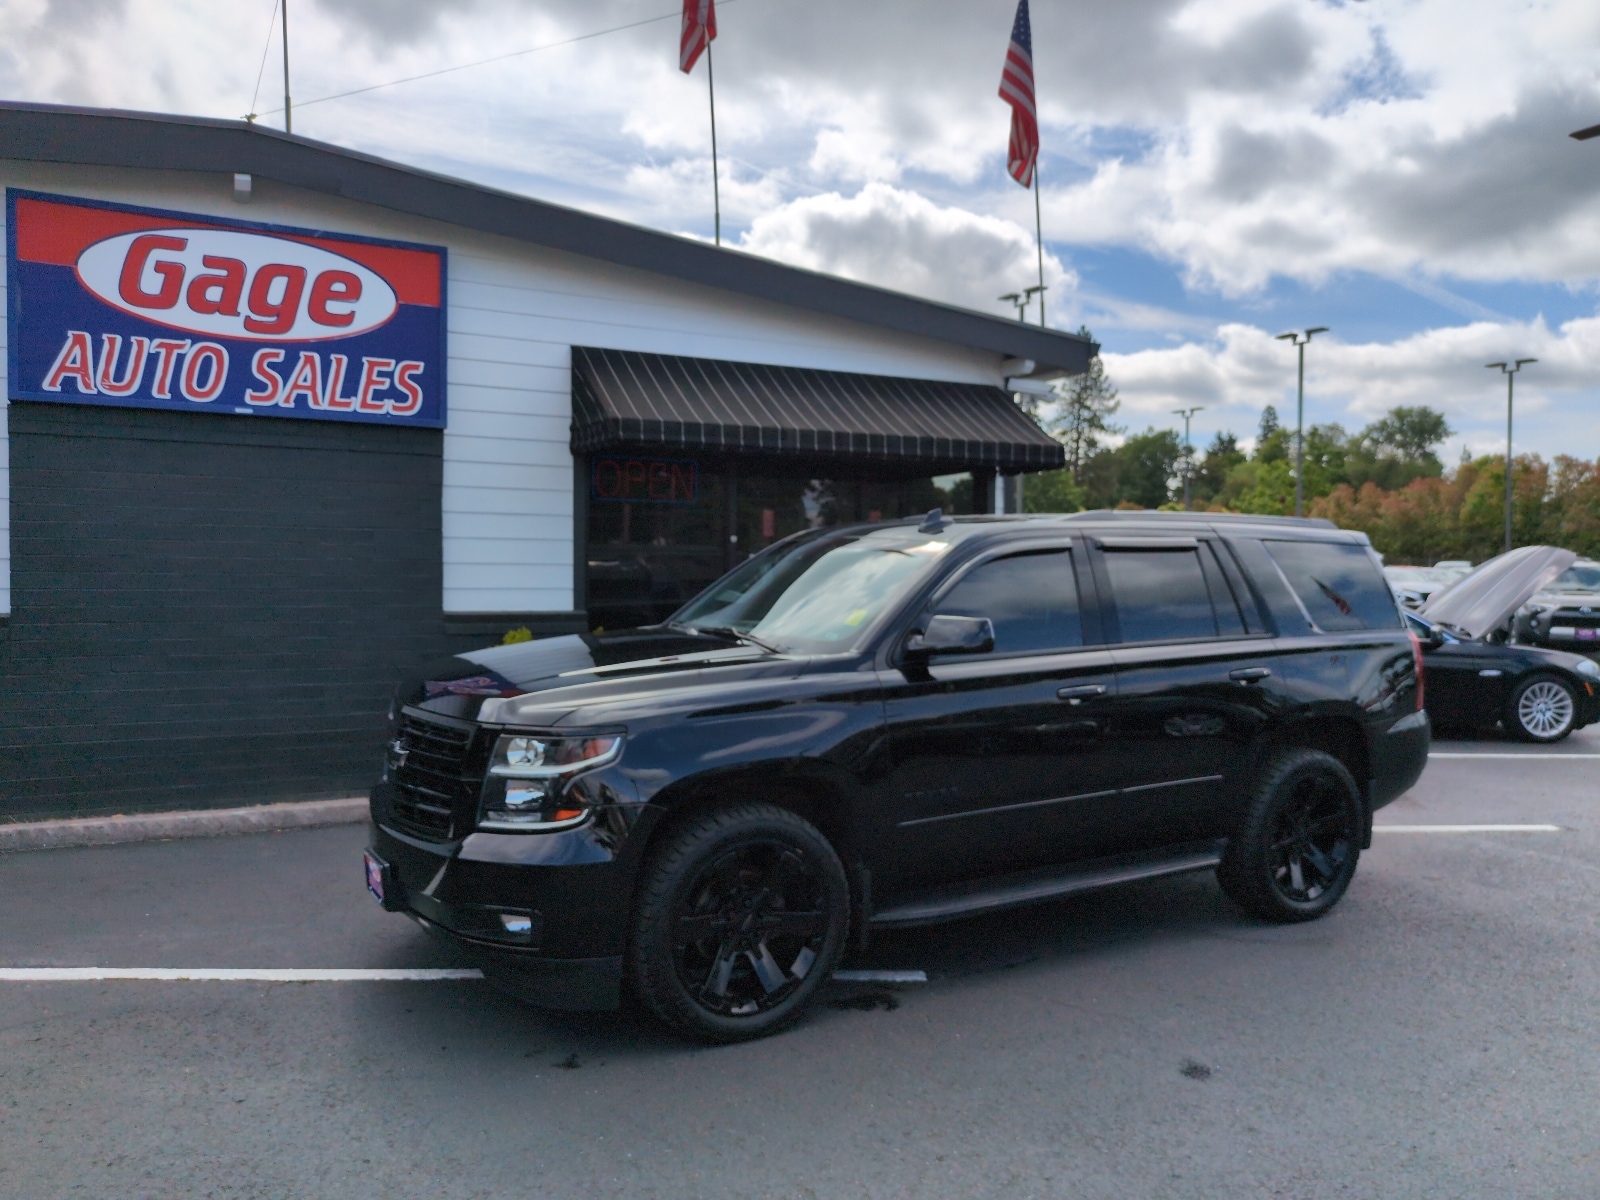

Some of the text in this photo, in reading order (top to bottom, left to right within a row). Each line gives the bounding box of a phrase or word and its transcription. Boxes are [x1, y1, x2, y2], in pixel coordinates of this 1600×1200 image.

[118, 234, 363, 334] Gage
[43, 331, 425, 416] AUTO SALES
[594, 459, 696, 500] OPEN
